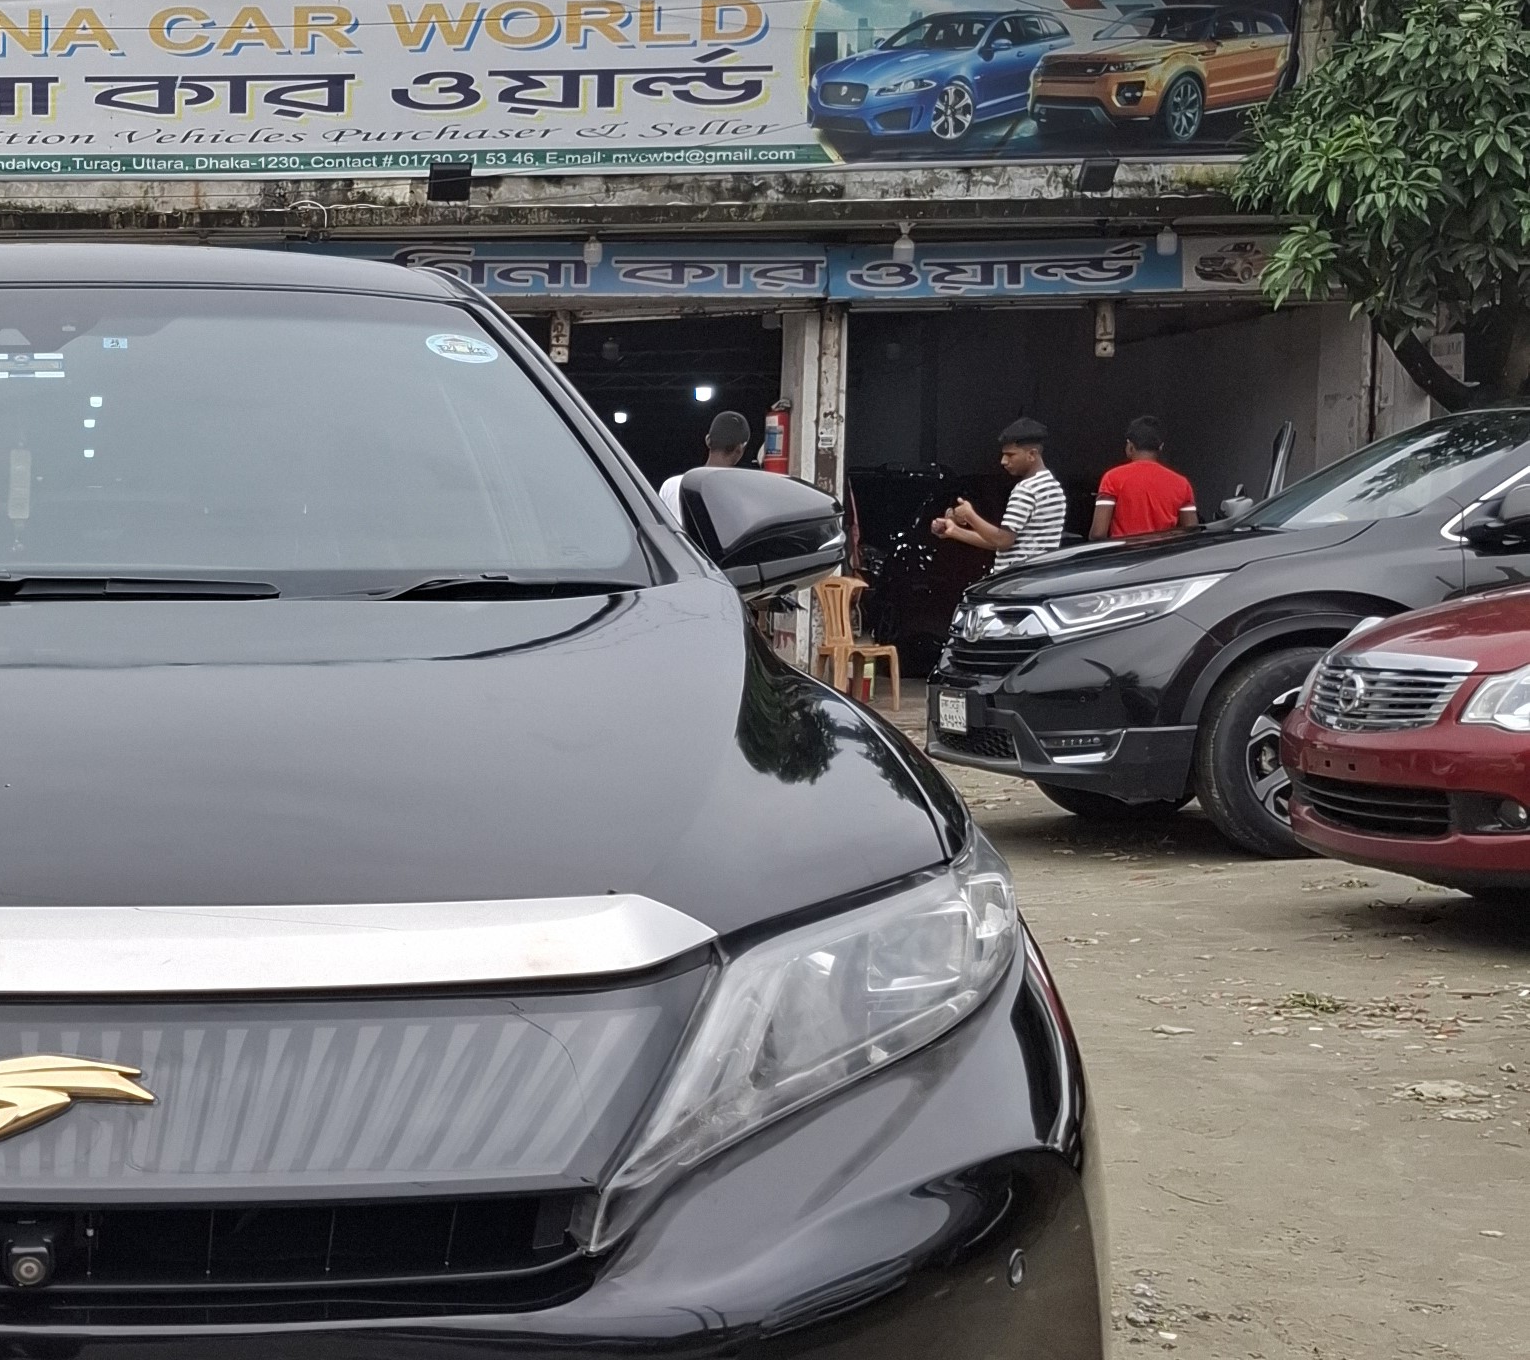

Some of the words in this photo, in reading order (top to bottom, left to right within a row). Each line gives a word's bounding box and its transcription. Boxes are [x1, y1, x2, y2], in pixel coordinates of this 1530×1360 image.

[148, 5, 361, 55] CAR
[85, 73, 356, 119] কার
[391, 47, 774, 115] ওয়ার্ল্ড
[114, 127, 308, 145] Vehicles
[322, 123, 562, 145] Purchaser
[638, 119, 781, 138] Seller
[132, 156, 190, 172] Uttara,
[195, 155, 305, 171] Dhaka-1230,
[311, 154, 378, 169] Contact
[381, 153, 393, 168] #
[485, 151, 507, 165] 53
[512, 151, 540, 166] 46,
[545, 150, 606, 165] E-mail:
[612, 147, 796, 165] mvcwbd@gmail.com
[612, 256, 827, 290] কার
